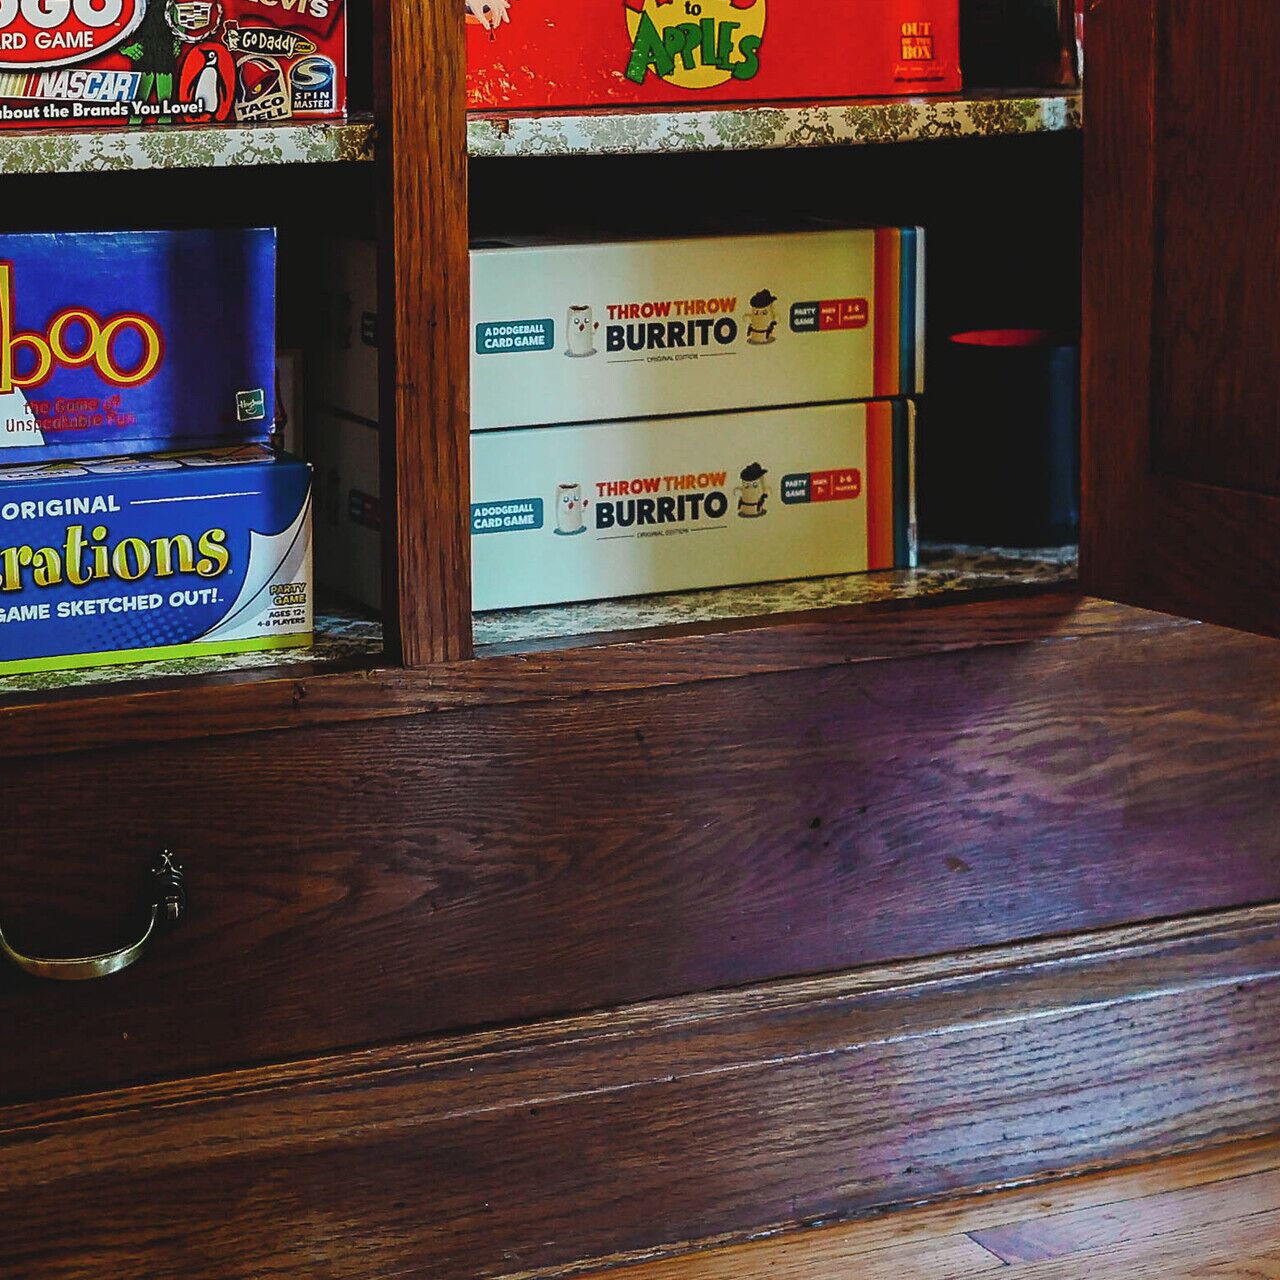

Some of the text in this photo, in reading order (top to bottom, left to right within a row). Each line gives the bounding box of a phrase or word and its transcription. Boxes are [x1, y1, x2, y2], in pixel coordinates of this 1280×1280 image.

[685, 0, 702, 16] to
[901, 22, 931, 36] OUT
[35, 31, 93, 49] GAME
[625, 11, 762, 84] APPLES
[902, 46, 931, 60] BOX
[36, 72, 132, 102] NASCAR
[294, 91, 329, 100] SPIN
[43, 102, 69, 117] the
[73, 100, 129, 117] Brands
[132, 99, 160, 115] You
[163, 98, 203, 114] Love!
[238, 97, 286, 116] TACO
[293, 100, 330, 109] MASTER
[607, 297, 737, 320] THROW THROW
[485, 324, 545, 337] A DODGEBALL
[606, 317, 738, 353] BURRITO
[485, 335, 545, 349] CARD GAME
[23, 401, 49, 415] the
[596, 472, 726, 497] THROW THROW
[1, 493, 121, 521] ORIGINAL
[474, 503, 533, 517] A DODGEBALL
[595, 491, 728, 529] BURRITO
[474, 514, 534, 529] CARD GAME
[269, 582, 306, 596] PARTY
[56, 592, 163, 619] SKETCHED
[168, 587, 218, 607] OUT!
[273, 594, 306, 606] GAME
[269, 608, 305, 618] AGES 12+
[273, 617, 306, 626] PLAYERS
